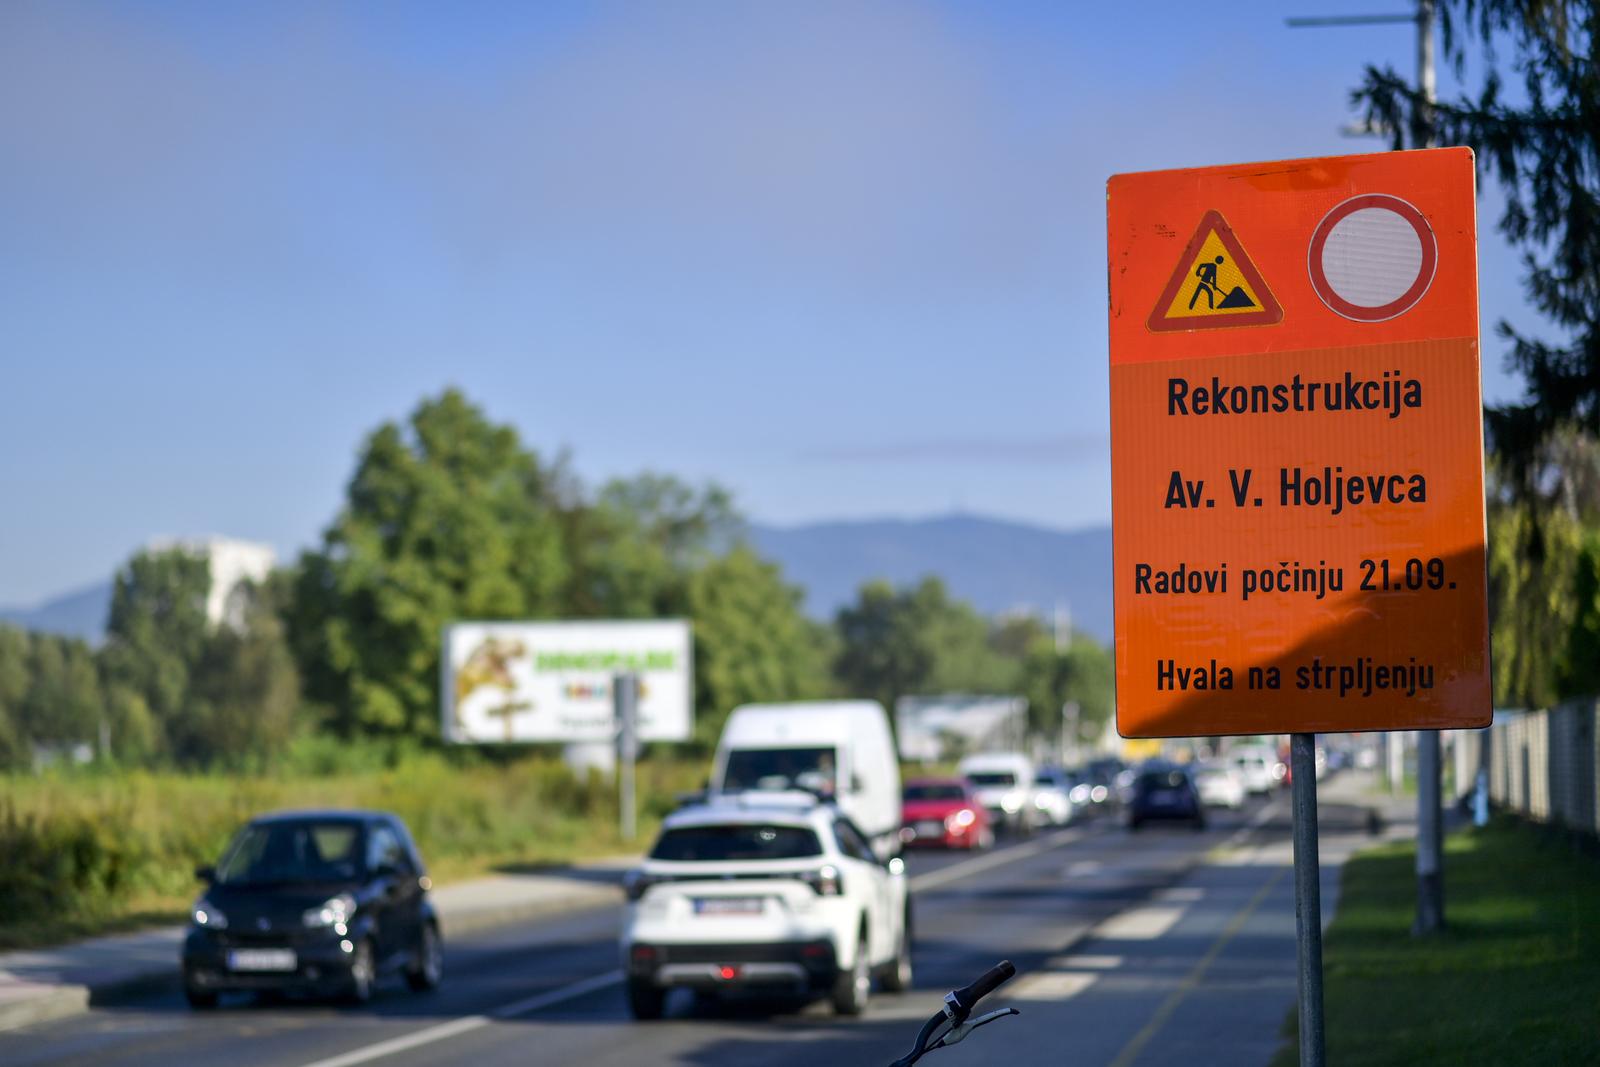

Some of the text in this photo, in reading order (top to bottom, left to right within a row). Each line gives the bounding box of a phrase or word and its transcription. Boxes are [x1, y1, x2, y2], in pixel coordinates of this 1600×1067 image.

[1169, 370, 1421, 418] Rekonstrukcija
[1165, 467, 1426, 515] Av. V. Holjevca
[1136, 558, 1456, 600] Radovi počinju 21.09.
[1158, 657, 1433, 697] Hvala na strpljenju
